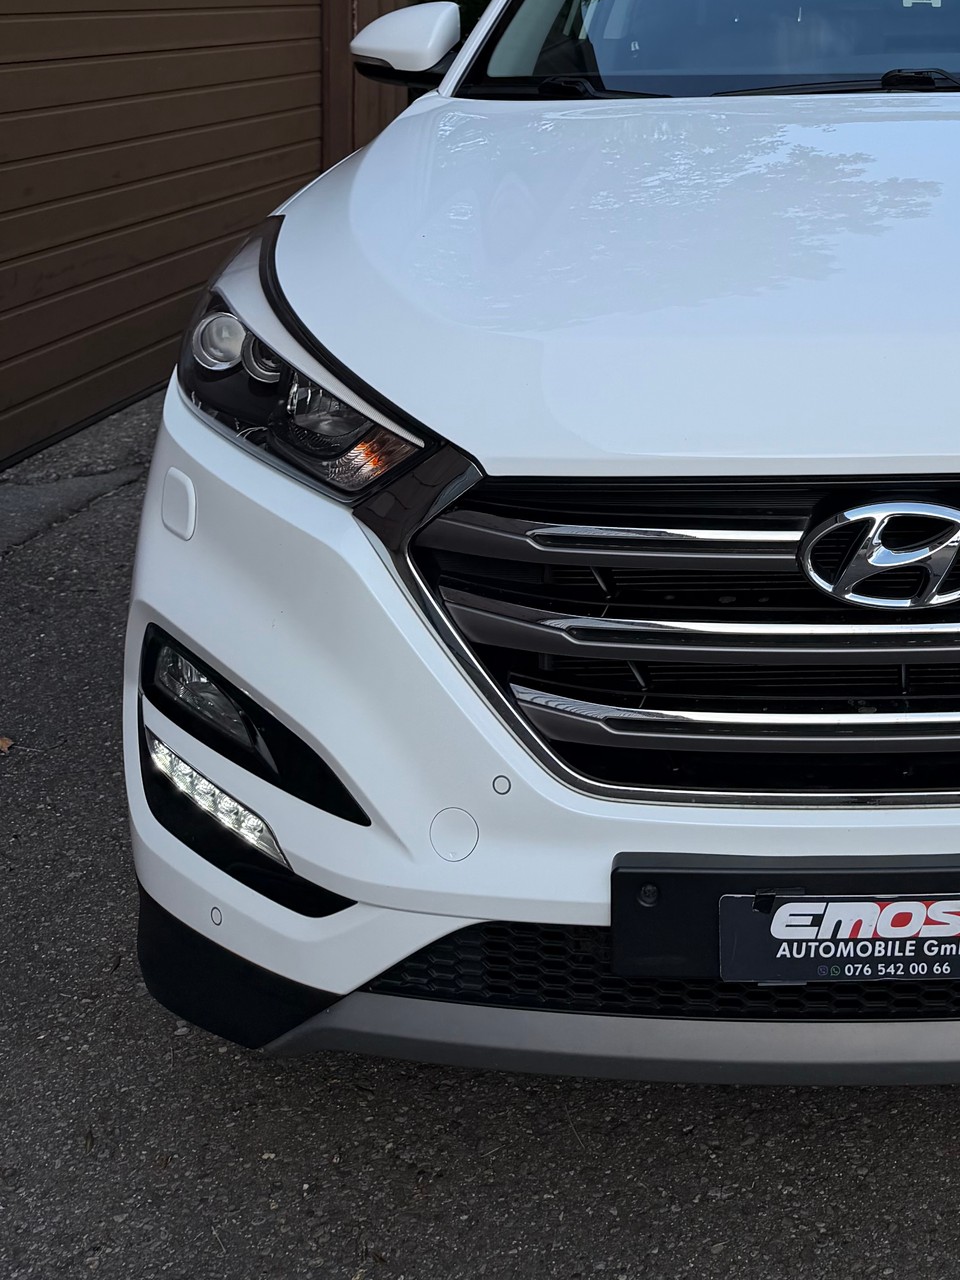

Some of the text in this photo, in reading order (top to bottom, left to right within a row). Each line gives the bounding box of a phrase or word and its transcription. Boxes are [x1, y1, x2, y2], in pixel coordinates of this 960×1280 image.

[776, 941, 916, 958] AUTOMOBILE
[844, 962, 951, 976] 076 542 00 66
